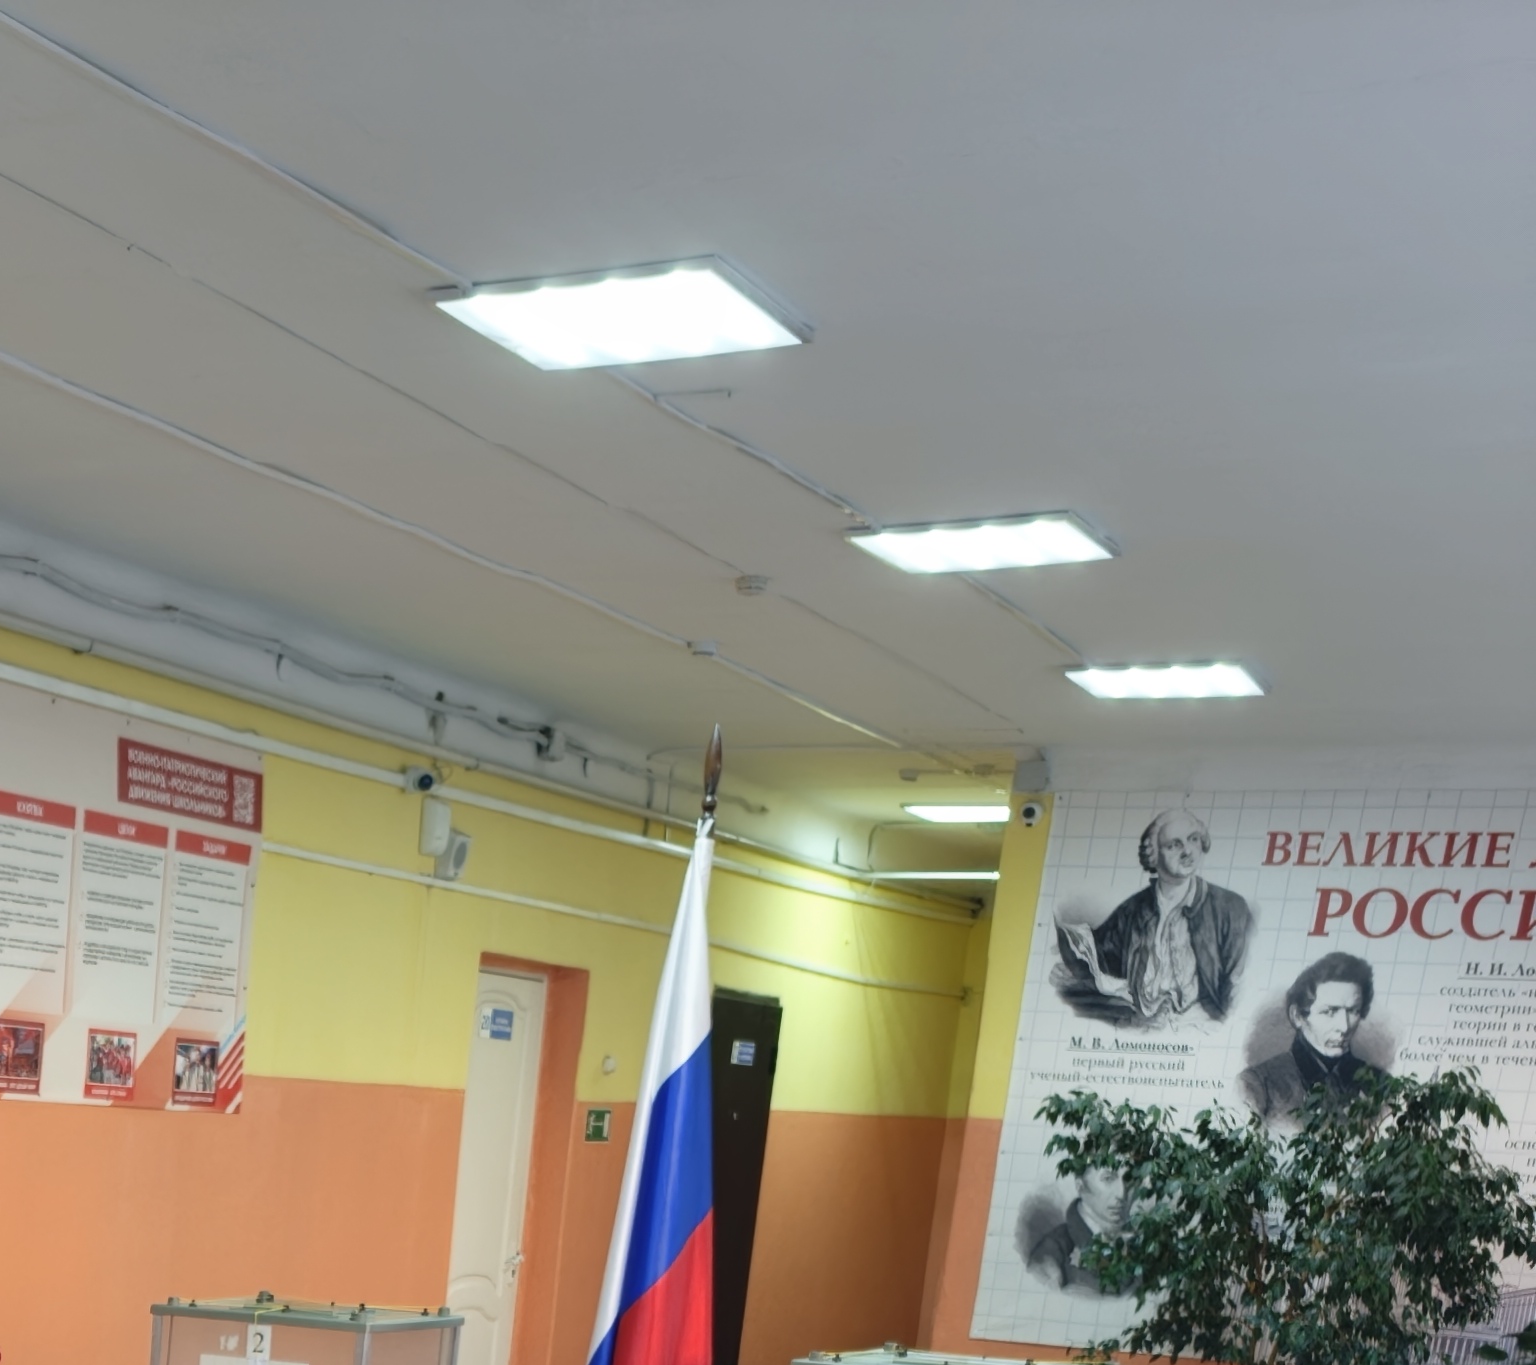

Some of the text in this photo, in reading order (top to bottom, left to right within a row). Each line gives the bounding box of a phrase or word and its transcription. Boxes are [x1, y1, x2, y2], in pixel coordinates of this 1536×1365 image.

[1261, 831, 1516, 869] ВЕЛИКИЕ
[1465, 962, 1483, 976] Н.
[1489, 962, 1507, 976] И.
[1439, 986, 1516, 998] создатель
[1453, 1020, 1521, 1035] теории в
[1069, 1036, 1086, 1050] М.
[1091, 1036, 1105, 1050] В.
[1417, 1035, 1508, 1050] служившей
[1399, 1047, 1443, 1063] более
[1448, 1053, 1476, 1064] чем
[1481, 1054, 1489, 1064] в
[1072, 1056, 1185, 1077] первый русский
[252, 1332, 265, 1355] 2
